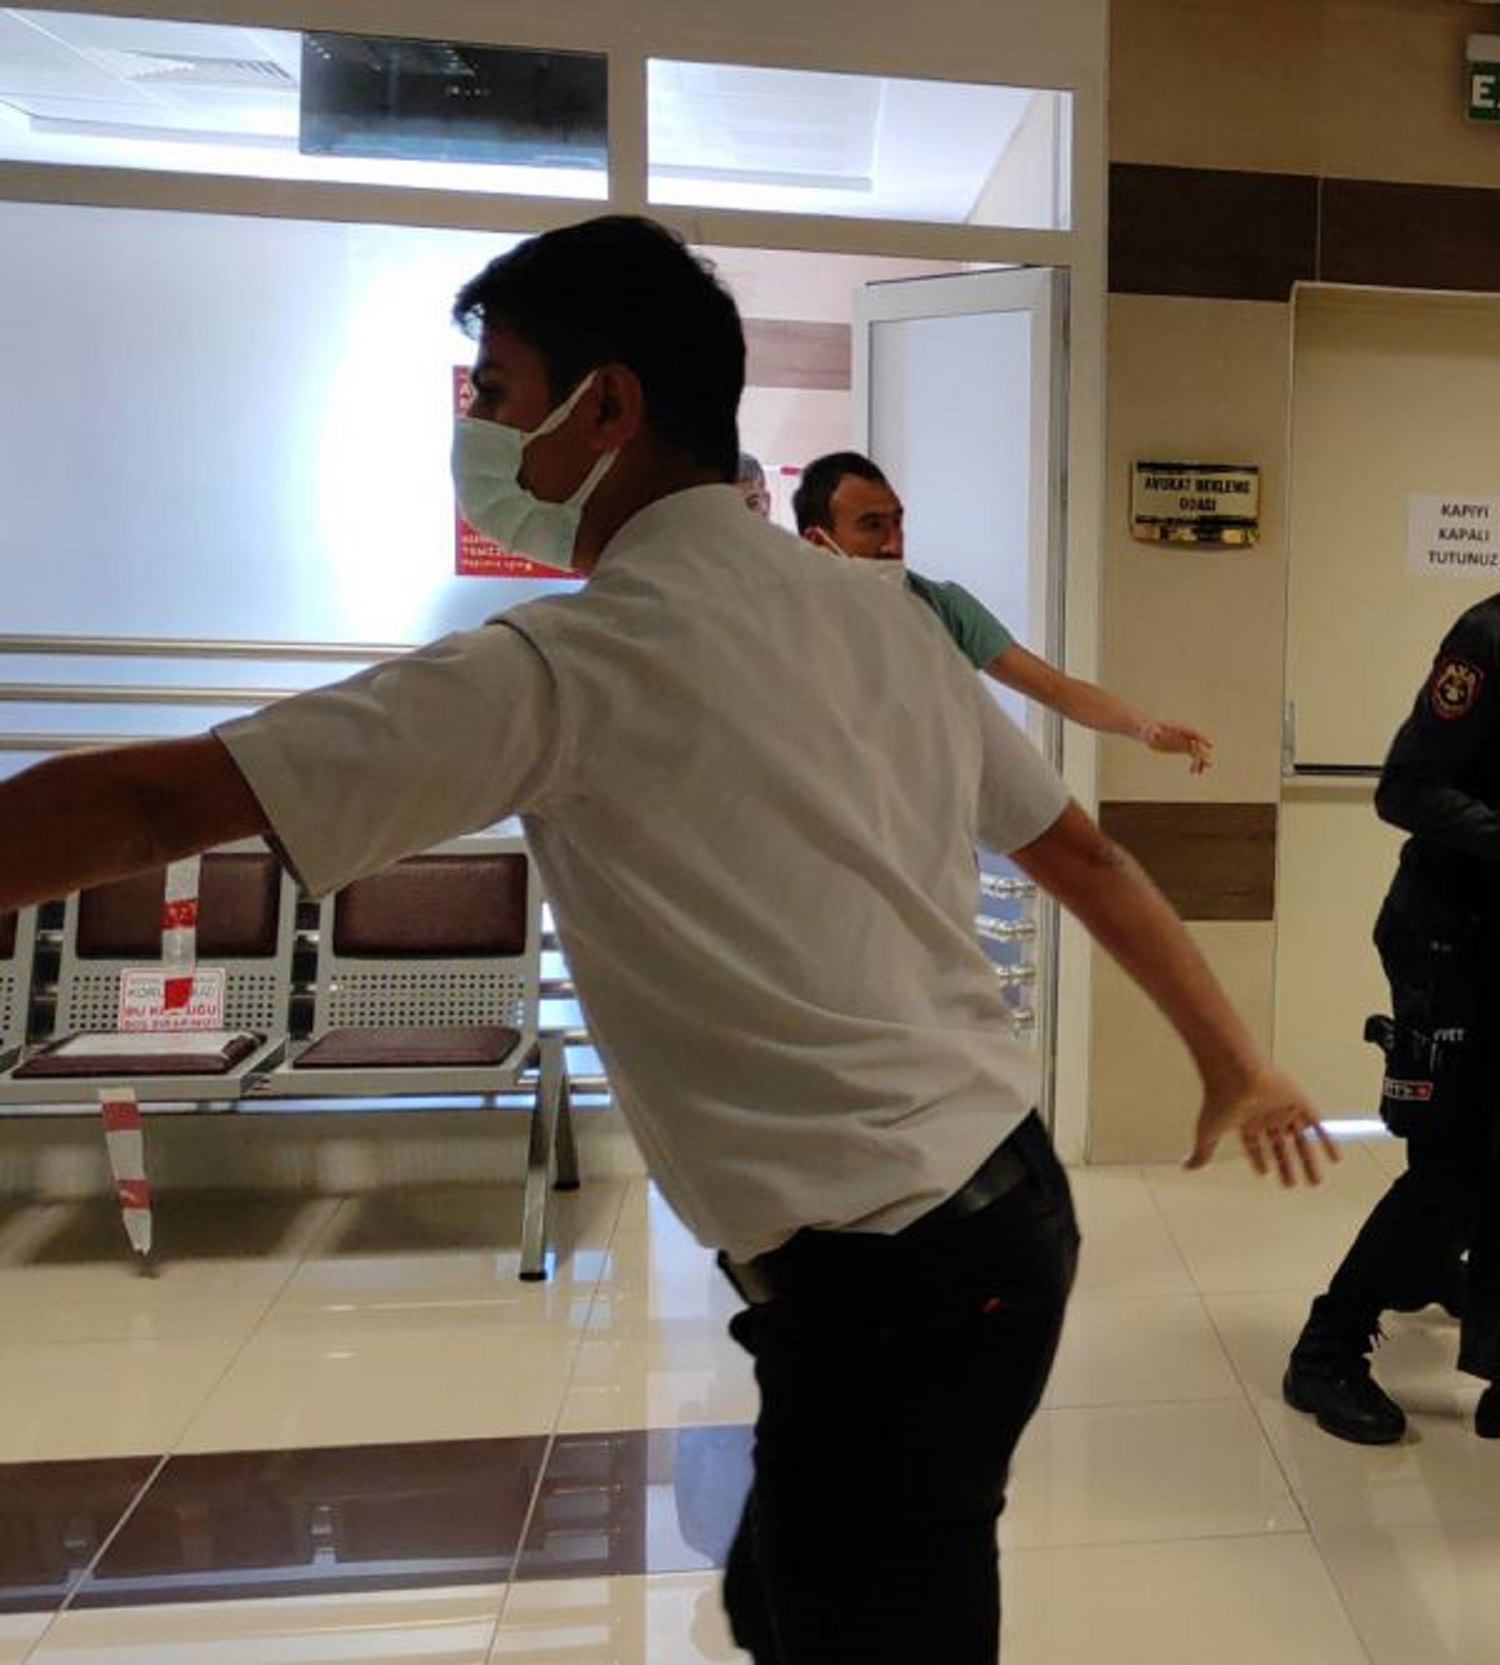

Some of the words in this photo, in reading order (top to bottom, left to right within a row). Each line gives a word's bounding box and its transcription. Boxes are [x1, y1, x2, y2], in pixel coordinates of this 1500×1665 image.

[1145, 476, 1191, 491] AVUKAT
[1195, 478, 1250, 494] BEKLEME
[1179, 498, 1217, 511] ODASI
[1441, 503, 1489, 518] KAPIYI
[1439, 527, 1490, 541] KAPALI
[1428, 550, 1499, 566] TUTUNUZ
